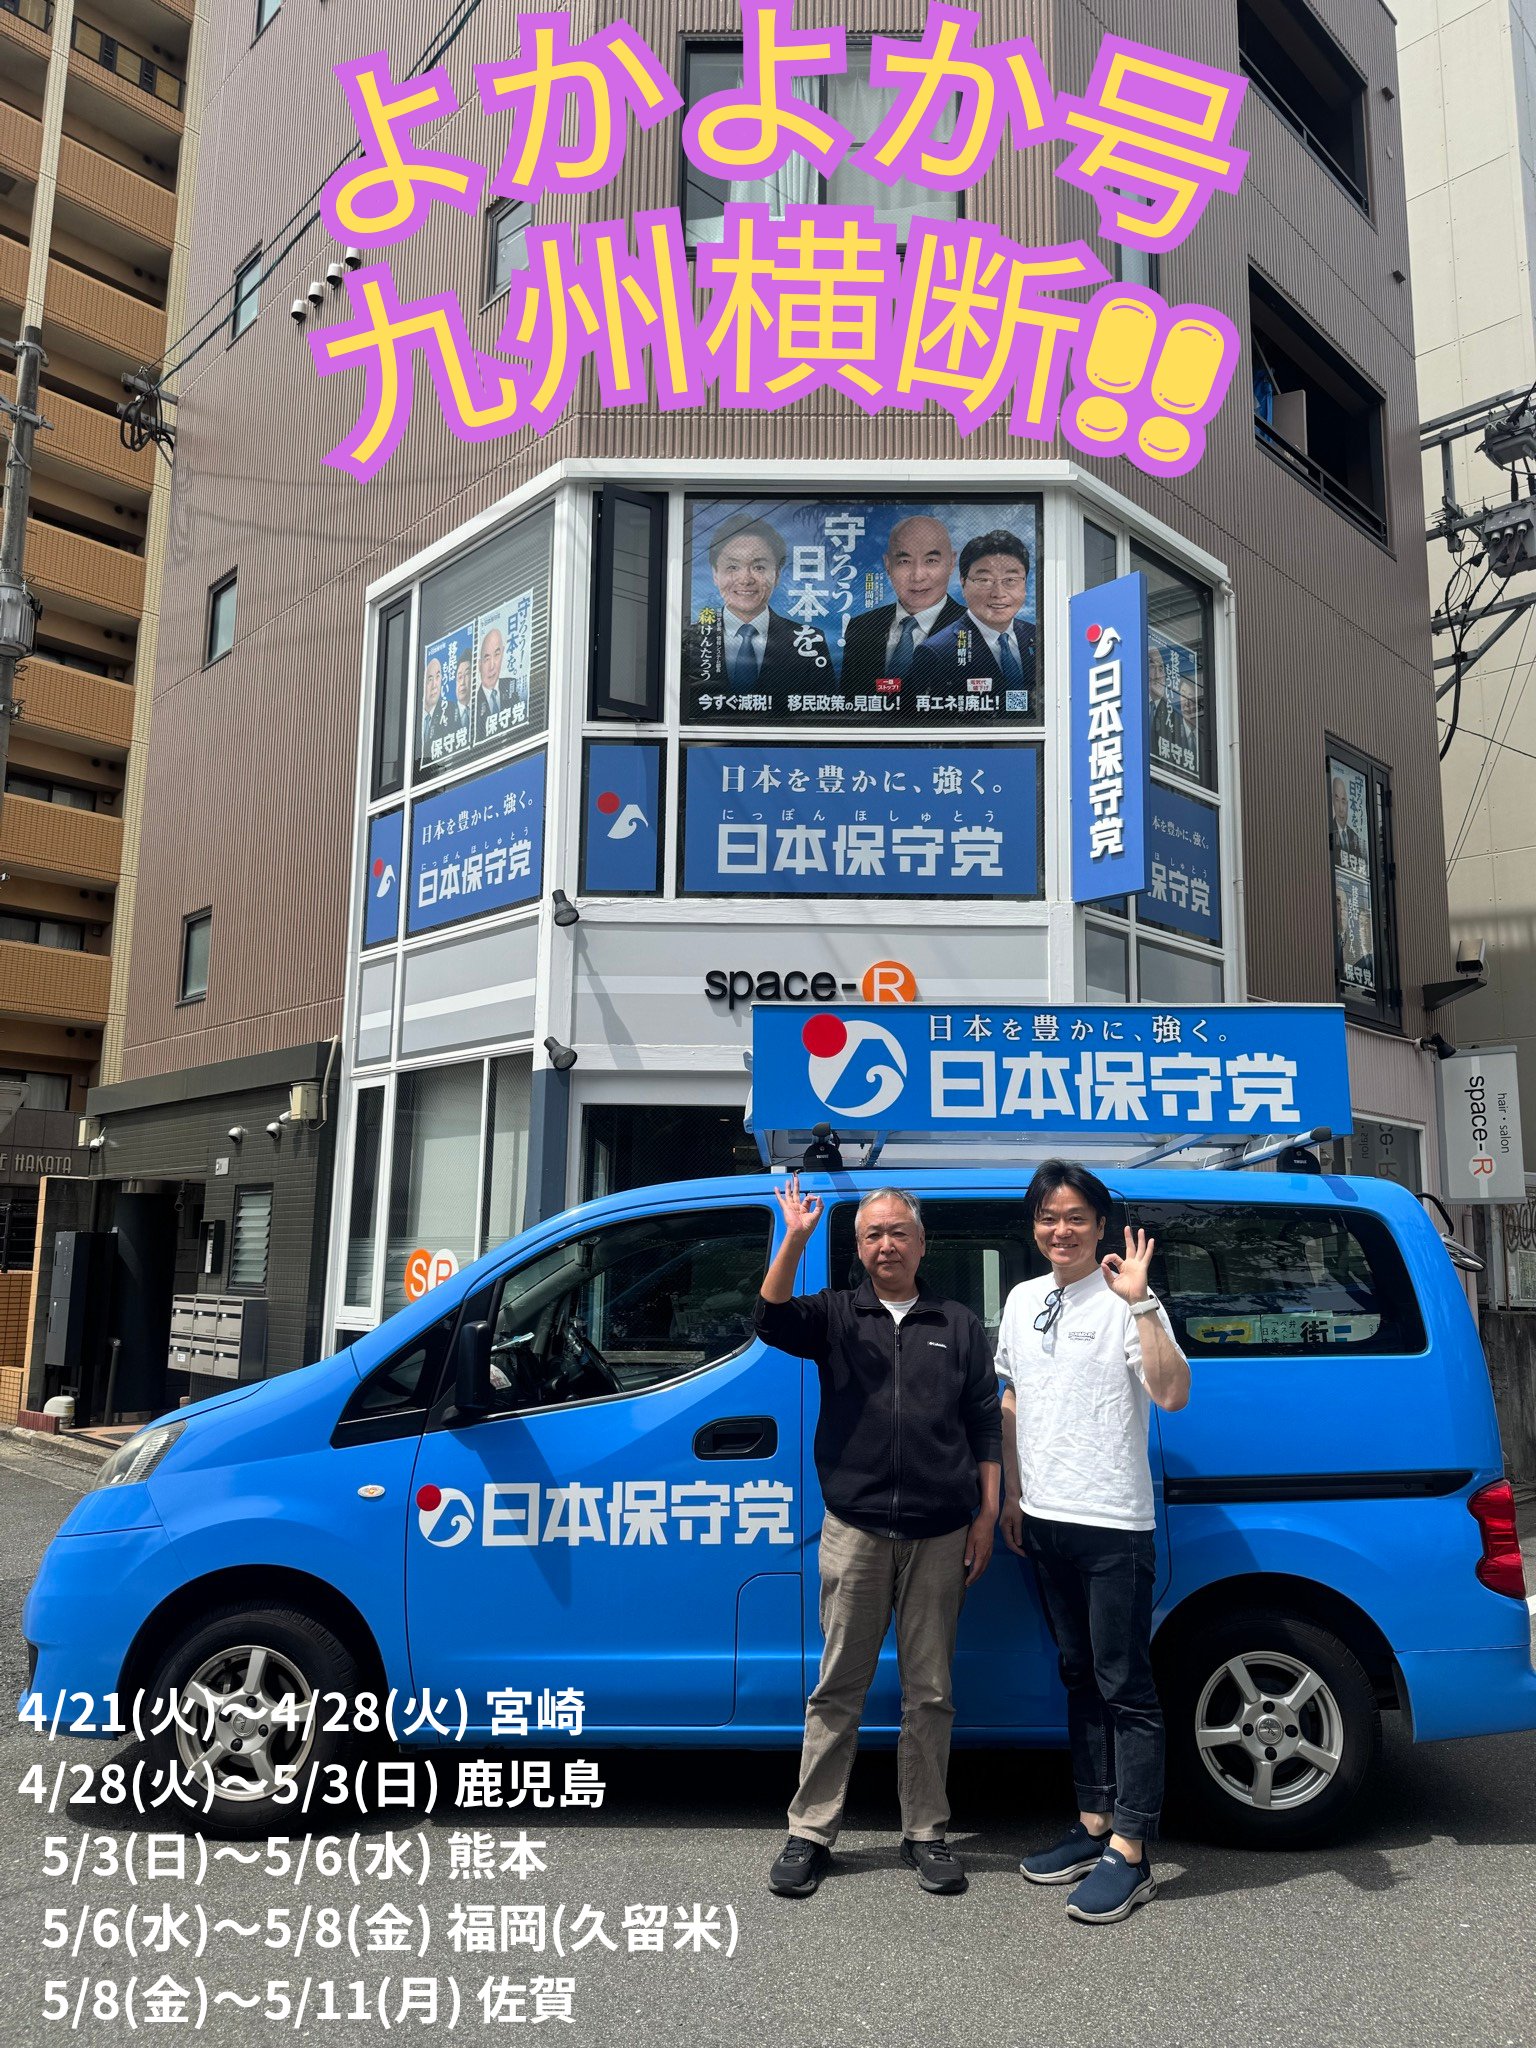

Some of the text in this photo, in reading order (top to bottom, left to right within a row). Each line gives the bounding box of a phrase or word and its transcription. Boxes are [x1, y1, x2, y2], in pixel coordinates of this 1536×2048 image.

[824, 512, 866, 648] 守ろう!
[787, 545, 830, 669] 日本を。
[506, 612, 519, 676] 日本を。
[698, 607, 717, 681] 森けんたろう
[485, 700, 526, 737] 保守党
[698, 693, 773, 713] 今すぐ減税!
[787, 693, 901, 713] 移民政策の見直し!
[431, 726, 468, 761] 保守党
[1088, 658, 1125, 860] 日本保守党
[1158, 736, 1195, 771] 保守党
[720, 764, 1004, 795] 日本を豊かに、強く。
[422, 790, 533, 845] 日本を豊かに、強く。
[418, 839, 532, 908] 日本保守党
[717, 824, 1004, 877] 日本保守党
[1340, 850, 1368, 877] 保守党
[704, 966, 906, 1010] space-R
[1345, 962, 1373, 988] 保守党
[929, 1014, 1229, 1044] 日本を豊かに、強く。
[930, 1050, 1301, 1123] 日本保守党
[1464, 1075, 1494, 1176] space-R
[15, 1154, 72, 1174] HAKATA
[482, 1479, 795, 1547] 日本保守党
